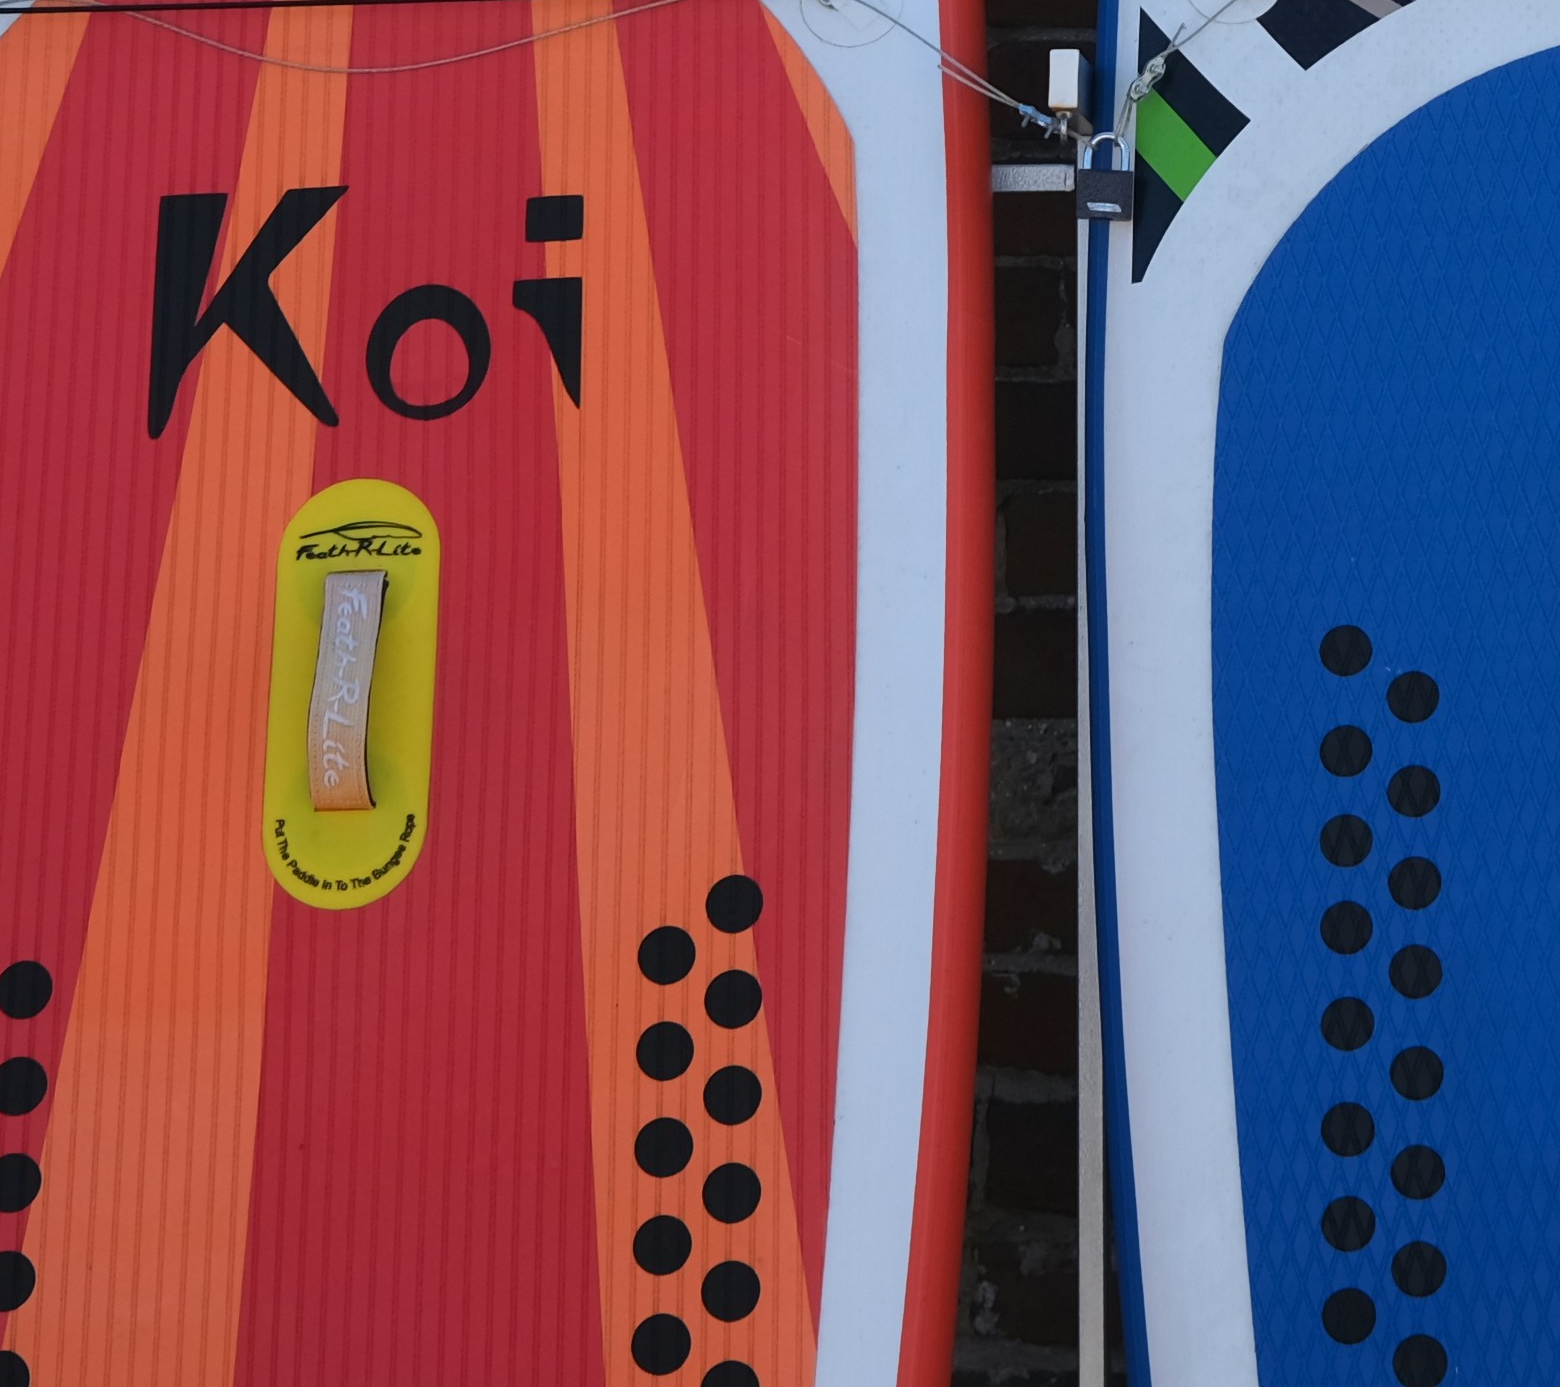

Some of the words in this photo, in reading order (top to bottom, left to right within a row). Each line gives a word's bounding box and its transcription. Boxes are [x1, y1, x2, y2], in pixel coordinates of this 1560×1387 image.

[148, 185, 584, 439] Koi
[322, 587, 368, 788] Feath-R-Lite
[274, 819, 285, 838] Put
[400, 813, 416, 843] Rope
[278, 837, 289, 860] The
[286, 859, 319, 887] Paddle
[372, 844, 406, 879] Bungee
[322, 879, 332, 890] In
[335, 880, 348, 891] To
[350, 876, 372, 889] The
